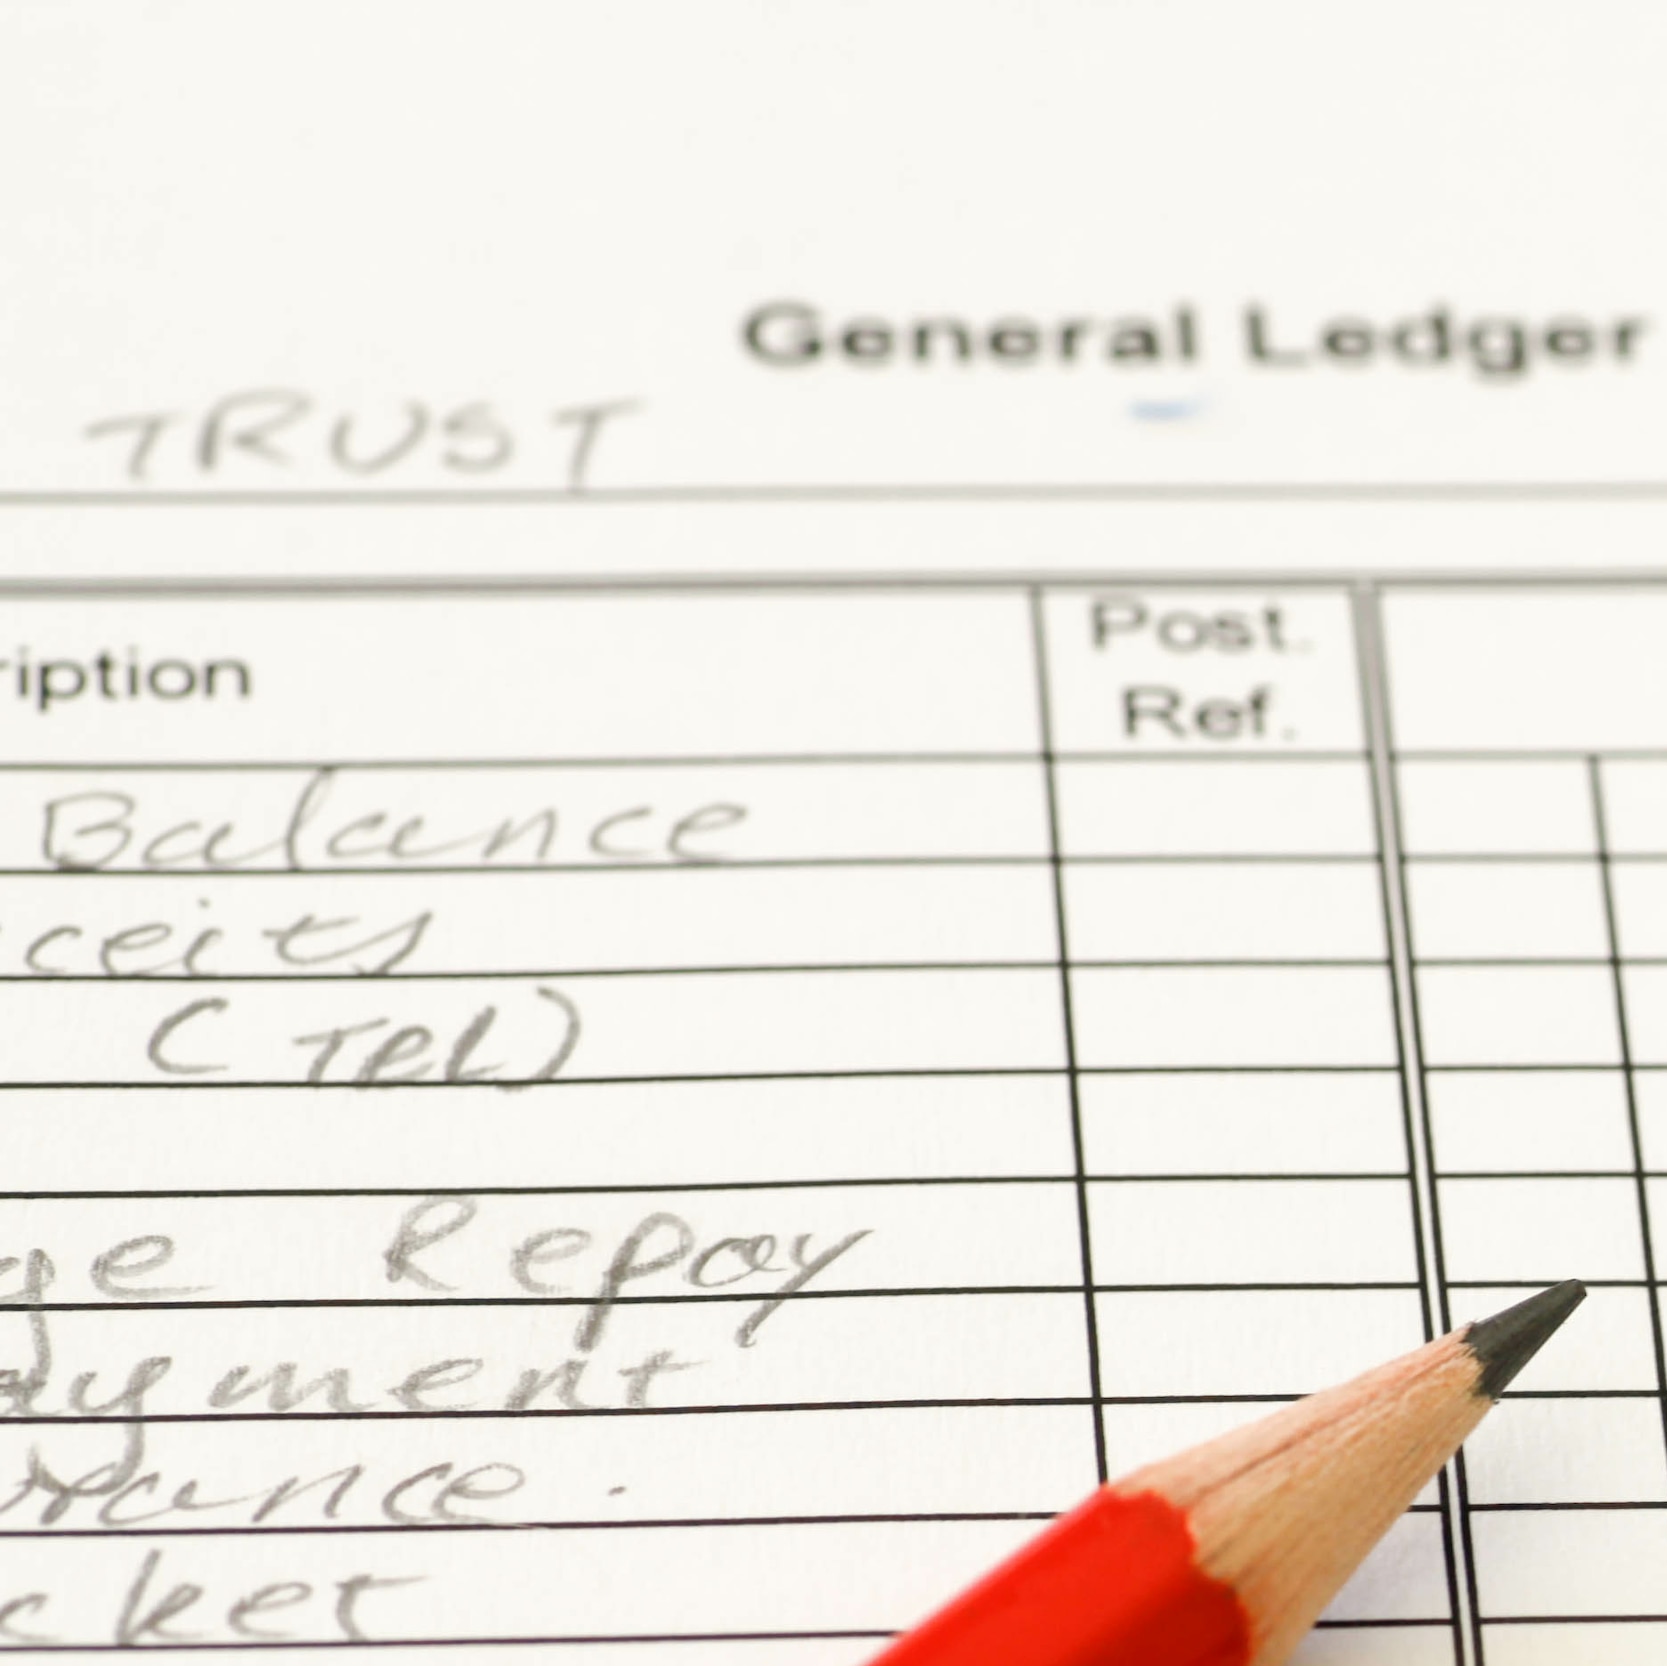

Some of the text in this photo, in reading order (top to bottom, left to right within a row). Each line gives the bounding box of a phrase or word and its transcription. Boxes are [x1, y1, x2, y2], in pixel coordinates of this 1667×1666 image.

[743, 301, 1649, 383] General Ledger
[83, 387, 646, 495] TRUST
[1091, 599, 1309, 654] Post.
[1124, 685, 1298, 741] Ref.
[41, 767, 748, 871] Balance
